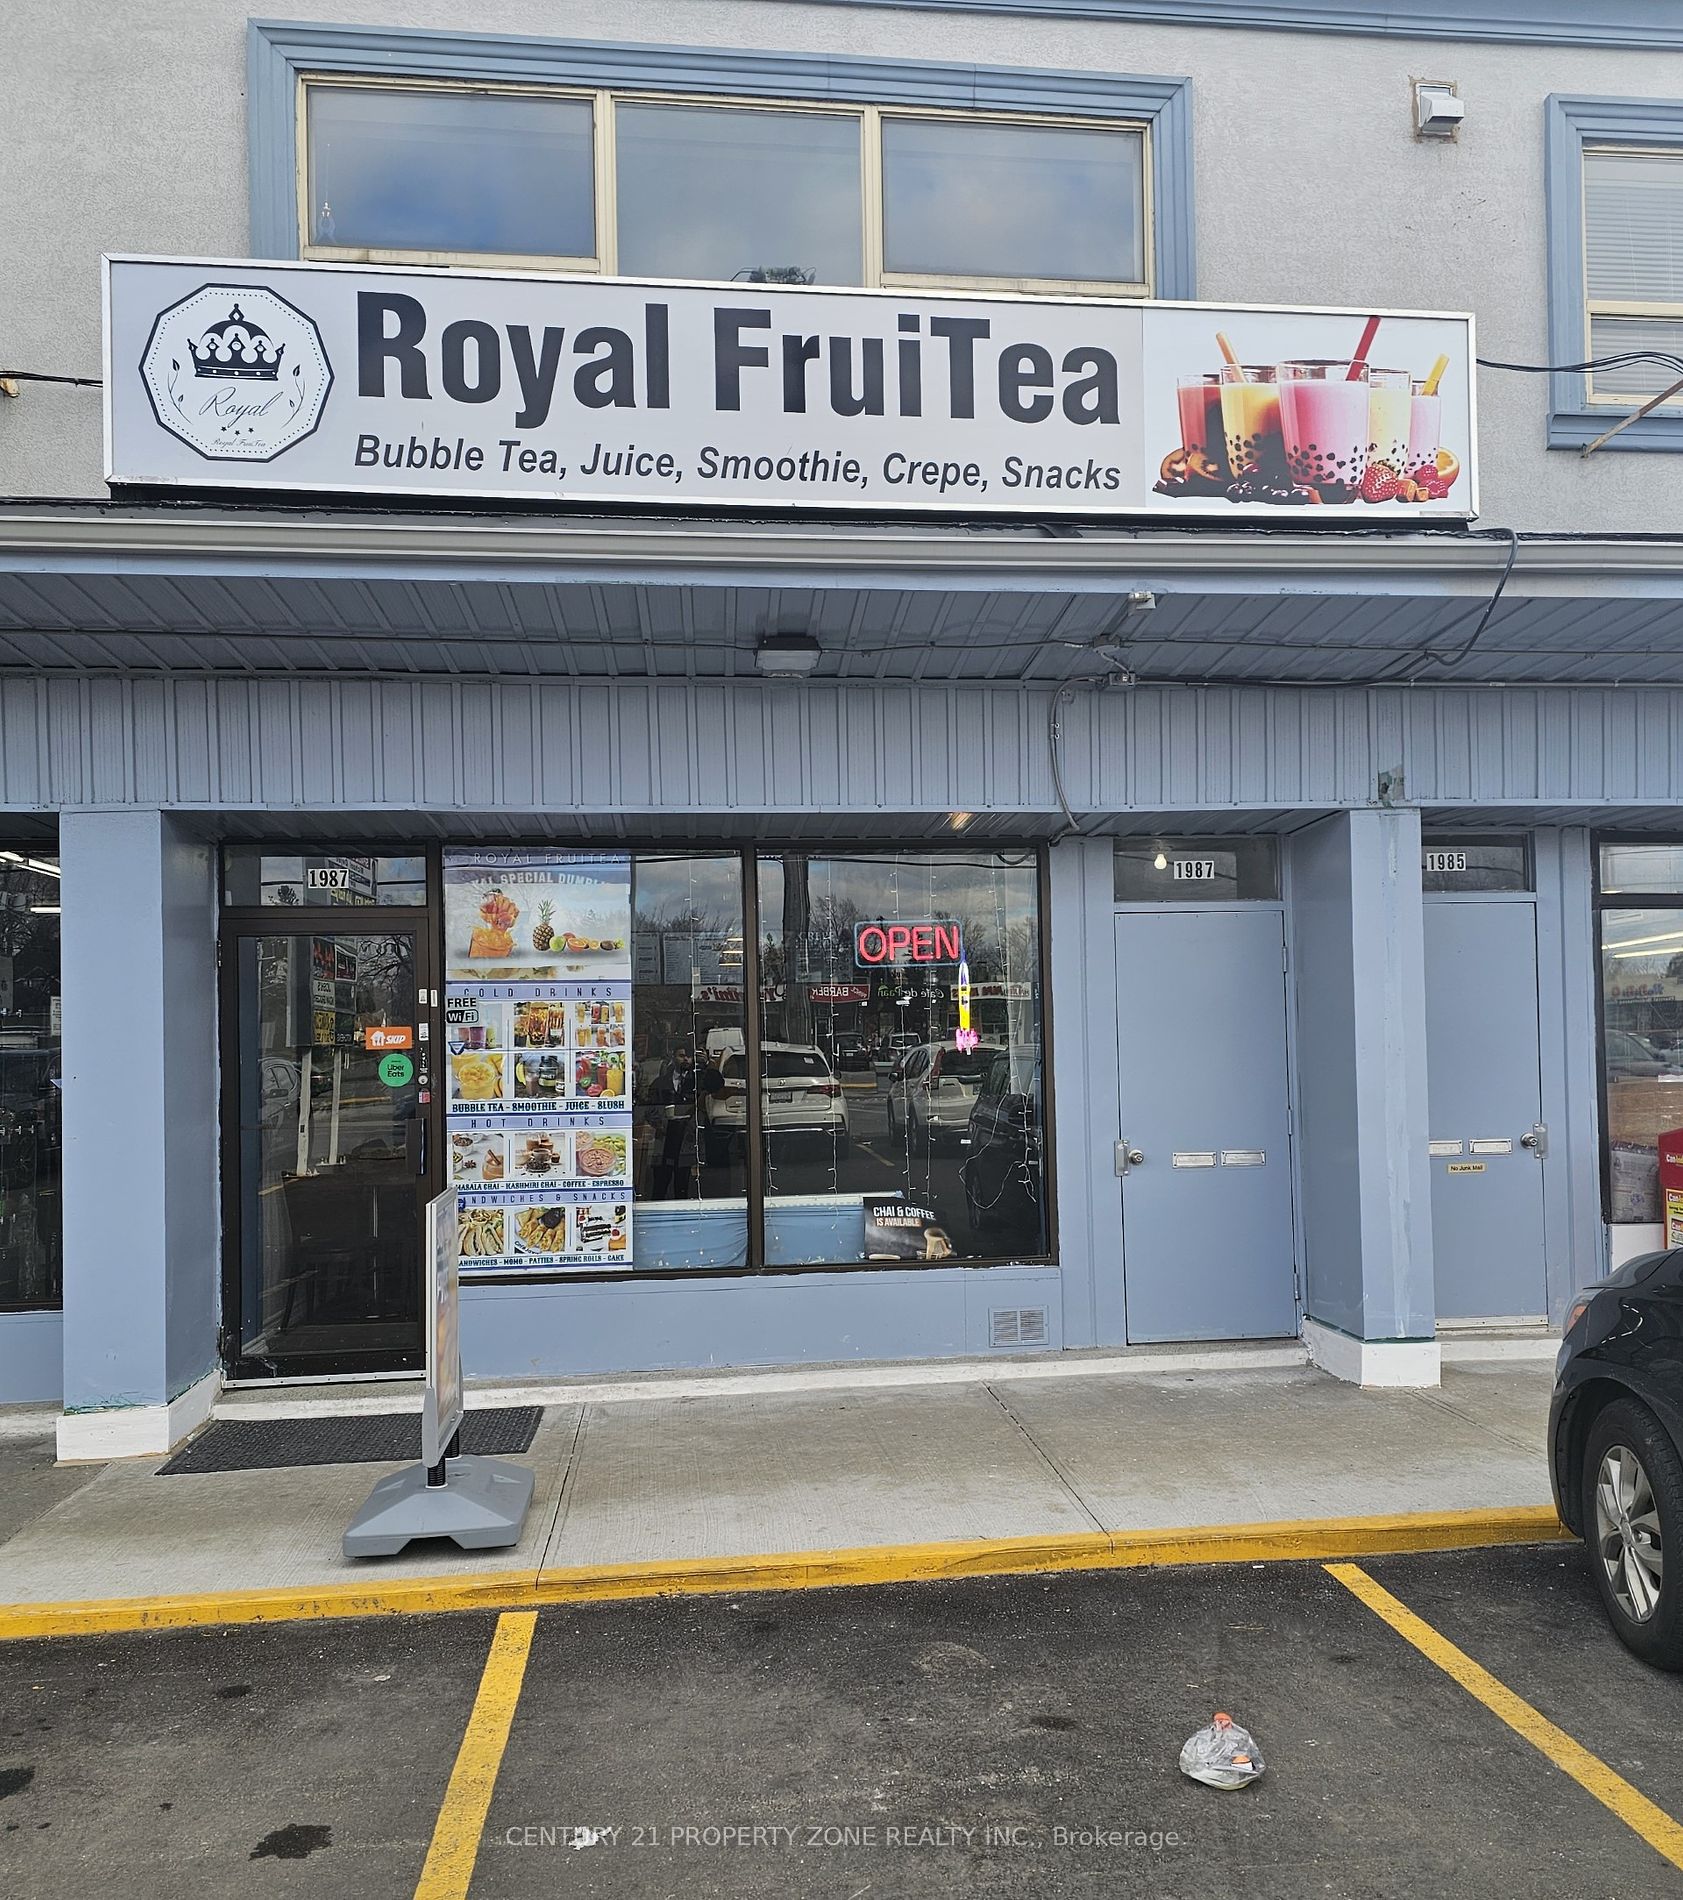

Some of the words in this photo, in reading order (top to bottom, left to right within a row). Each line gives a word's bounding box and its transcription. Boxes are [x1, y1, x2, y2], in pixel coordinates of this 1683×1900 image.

[358, 291, 671, 430] Royal
[714, 308, 1121, 425] FruiTea
[199, 386, 284, 429] Royal
[354, 435, 483, 472] Bubble
[499, 440, 567, 480] Tea,
[581, 444, 682, 484] Juice,
[697, 447, 868, 490] Smoothie,
[884, 453, 987, 493] Crepe,
[1002, 457, 1121, 490] Snacks
[473, 852, 533, 864] ROYAL
[545, 853, 620, 864] FRUITEA
[1429, 854, 1464, 870] 1985
[1176, 862, 1213, 878] 1987
[309, 869, 348, 887] 1987
[500, 871, 553, 884] SPECIAL
[859, 926, 959, 962] OPEN
[464, 988, 514, 997] COLD
[535, 987, 613, 997] DRINKS
[447, 997, 477, 1008] FREE
[386, 1035, 406, 1044] SKIP
[452, 1103, 486, 1112] BUBBLE
[487, 1103, 504, 1112] TEA
[512, 1102, 557, 1111] SMOOTHIE
[565, 1102, 589, 1110] JUICE
[597, 1101, 625, 1110] SLUSH
[471, 1118, 507, 1128] HOT
[527, 1116, 604, 1126] DRINKS
[506, 1182, 540, 1190] KASHMIRI
[540, 1181, 557, 1189] CHAI
[465, 1194, 544, 1204] NDWICHES
[573, 1192, 626, 1201] SNACKS
[873, 1206, 895, 1217] CHAI
[897, 1206, 904, 1217] &
[905, 1206, 936, 1220] COFFEE
[876, 1218, 884, 1226] IS
[884, 1217, 922, 1227] AVAILABLE
[503, 1257, 523, 1265] MOMO
[529, 1256, 554, 1264] PATTIES
[559, 1255, 582, 1263] SPRING
